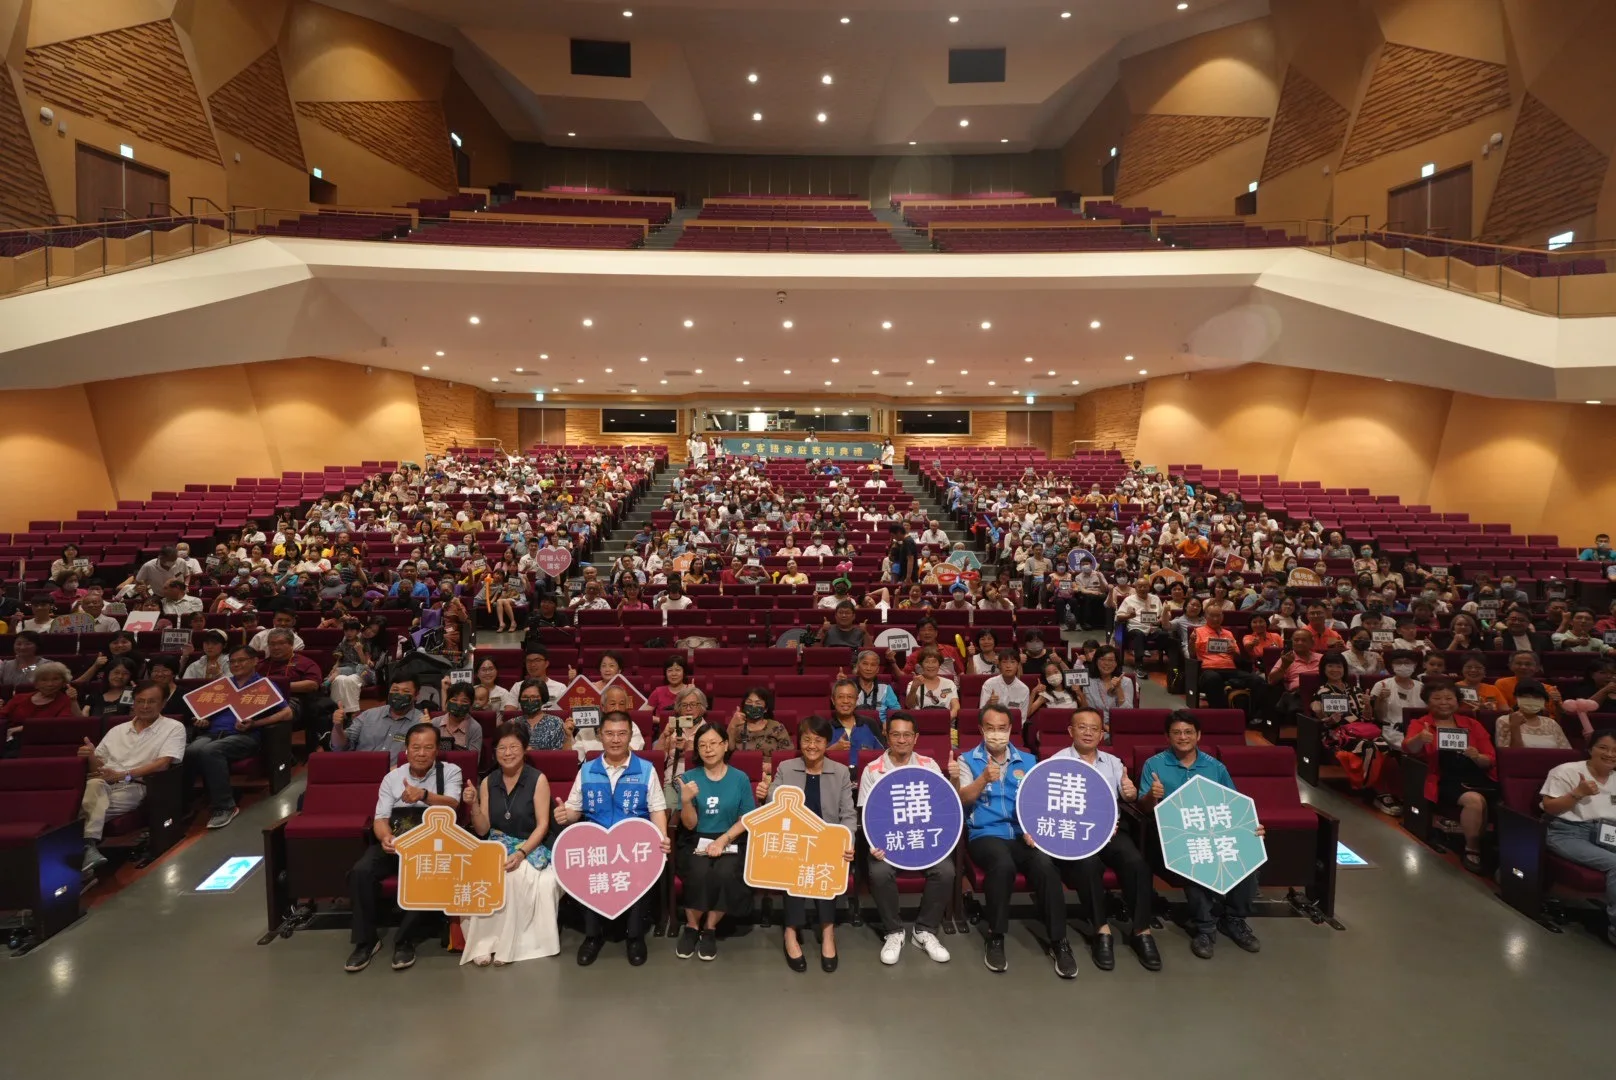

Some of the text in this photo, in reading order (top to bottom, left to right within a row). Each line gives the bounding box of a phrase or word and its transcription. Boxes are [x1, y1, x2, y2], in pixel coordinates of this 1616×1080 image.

[197, 692, 269, 705] 講客 有福
[890, 781, 932, 825] 講
[1047, 772, 1087, 816] 講
[1036, 816, 1096, 841] 就著了
[1180, 803, 1233, 831] 時時
[885, 827, 945, 851] 就著了
[1186, 835, 1239, 865] 講客
[565, 842, 653, 869] 同細人仔
[588, 871, 632, 895] 講客
[798, 863, 835, 891] 講客
[453, 879, 493, 908] 講客
